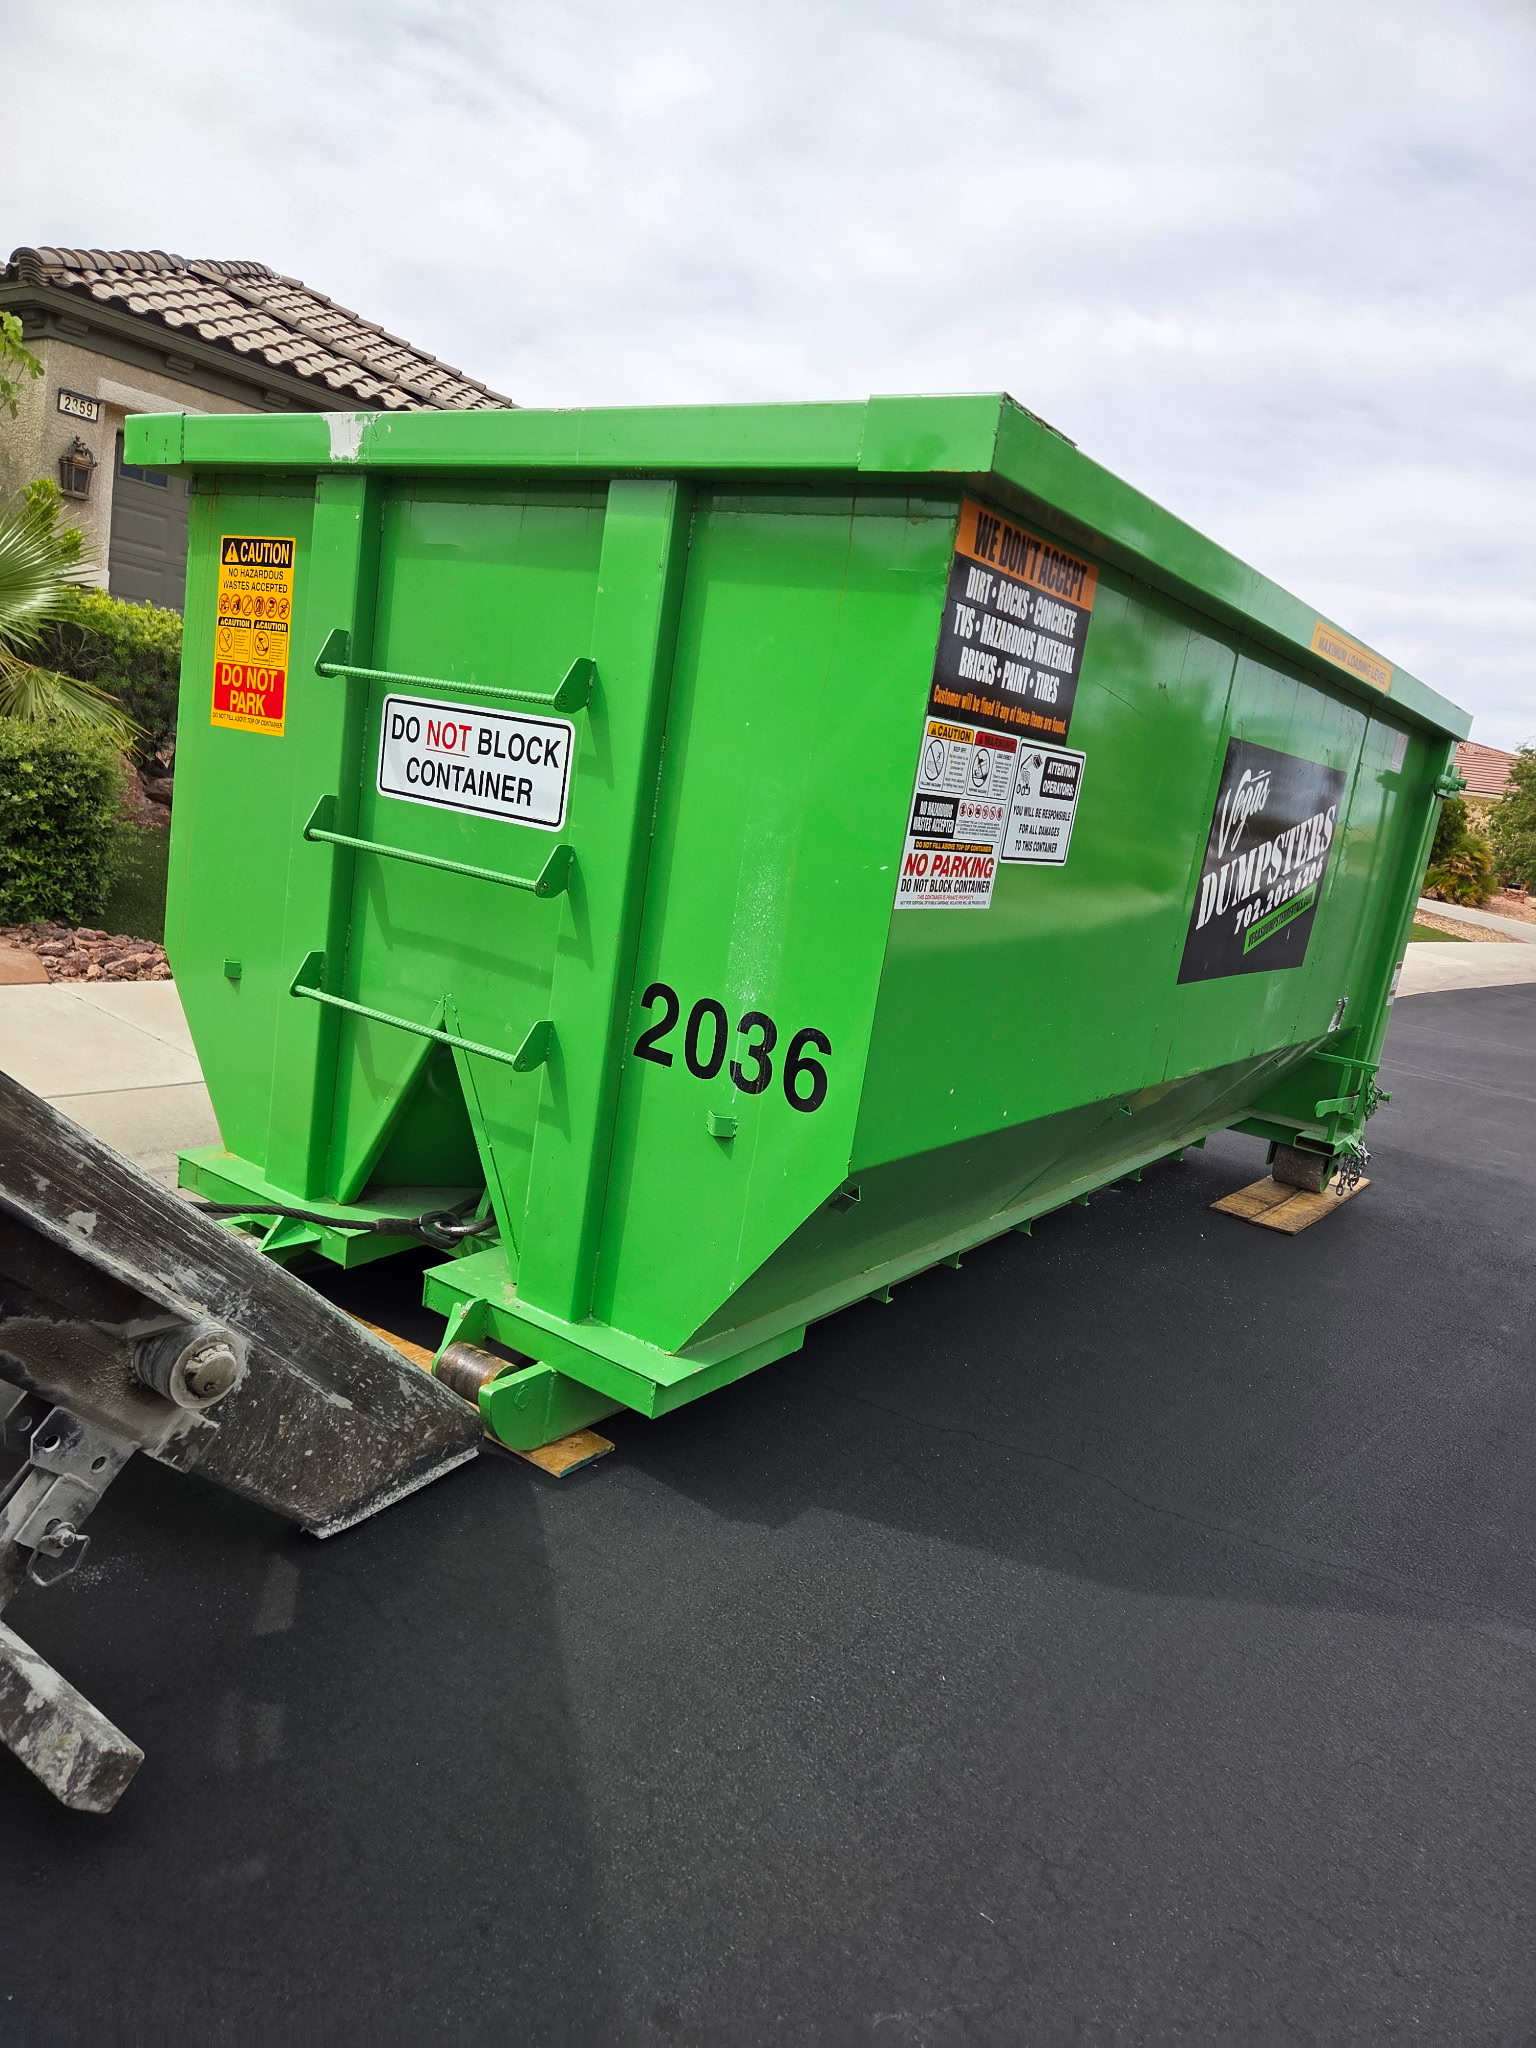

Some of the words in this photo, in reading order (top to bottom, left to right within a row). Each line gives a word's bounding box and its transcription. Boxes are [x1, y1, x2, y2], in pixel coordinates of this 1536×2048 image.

[65, 396, 93, 417] 2359
[240, 541, 290, 565] CAUTION
[973, 511, 1001, 563] WE
[998, 523, 1042, 590] DON'T
[1037, 546, 1088, 602] ACCEPT
[228, 568, 239, 578] NO
[240, 569, 284, 580] HAZARDOUS
[223, 580, 250, 591] WASTES
[250, 582, 288, 594] ACCEPTED
[965, 566, 994, 605] DIRT
[996, 579, 1030, 620] ROCKS
[1033, 596, 1078, 639] CONCRETE
[224, 618, 250, 628] CAUTION
[260, 622, 287, 631] CAUTION
[953, 603, 976, 639] TVS
[979, 613, 1037, 661] HAZARDOUS
[1034, 634, 1076, 674] MATERIAL
[1318, 636, 1348, 663] MAXIMUM
[1346, 652, 1371, 676] LOADING
[1370, 666, 1386, 685] LEVEL
[221, 663, 243, 688] DO
[246, 667, 278, 693] NOT
[958, 646, 998, 686] BRICKS
[1001, 660, 1031, 695] PAINT
[1033, 671, 1060, 704] TIRES
[229, 690, 266, 716] PARK
[933, 684, 961, 708] Customer
[961, 692, 973, 710] will
[971, 695, 980, 712] be
[980, 696, 995, 716] fined
[994, 701, 1001, 717] if
[1000, 704, 1010, 723] any
[1009, 706, 1018, 721] of
[1016, 707, 1030, 725] these
[1030, 711, 1044, 728] items
[1043, 715, 1052, 731] are
[391, 713, 420, 743] DO
[426, 719, 472, 752] NOT
[477, 727, 562, 769] BLOCK
[937, 726, 972, 742] CAUTION
[406, 757, 533, 806] CONTAINER
[1047, 761, 1077, 779] ATTENTION
[1042, 779, 1075, 797] OPERATORS:
[912, 816, 932, 832] WASTES
[931, 818, 955, 834] ACCEPTED
[1013, 805, 1023, 816] YOU
[1023, 806, 1034, 817] WILL
[1035, 808, 1042, 818] BE
[1041, 808, 1071, 821] RESPONSIBLE
[1218, 768, 1271, 859] Vegas
[1019, 823, 1029, 834] FOR
[1029, 825, 1038, 835] ALL
[1038, 825, 1060, 837] DAMAGES
[970, 845, 992, 853] CONTAINER
[1015, 840, 1022, 851] TO
[1022, 840, 1033, 852] THIS
[1033, 841, 1057, 853] CONTAINER
[902, 853, 929, 877] NO
[929, 854, 995, 879] PARKING
[1195, 804, 1337, 931] DUMPSTERS
[900, 878, 912, 892] DO
[912, 879, 929, 893] NOT
[929, 879, 954, 893] BLOCK
[953, 880, 991, 894] CONTAINER
[1234, 856, 1324, 935] 702.202.6206
[632, 982, 832, 1113] 2036
